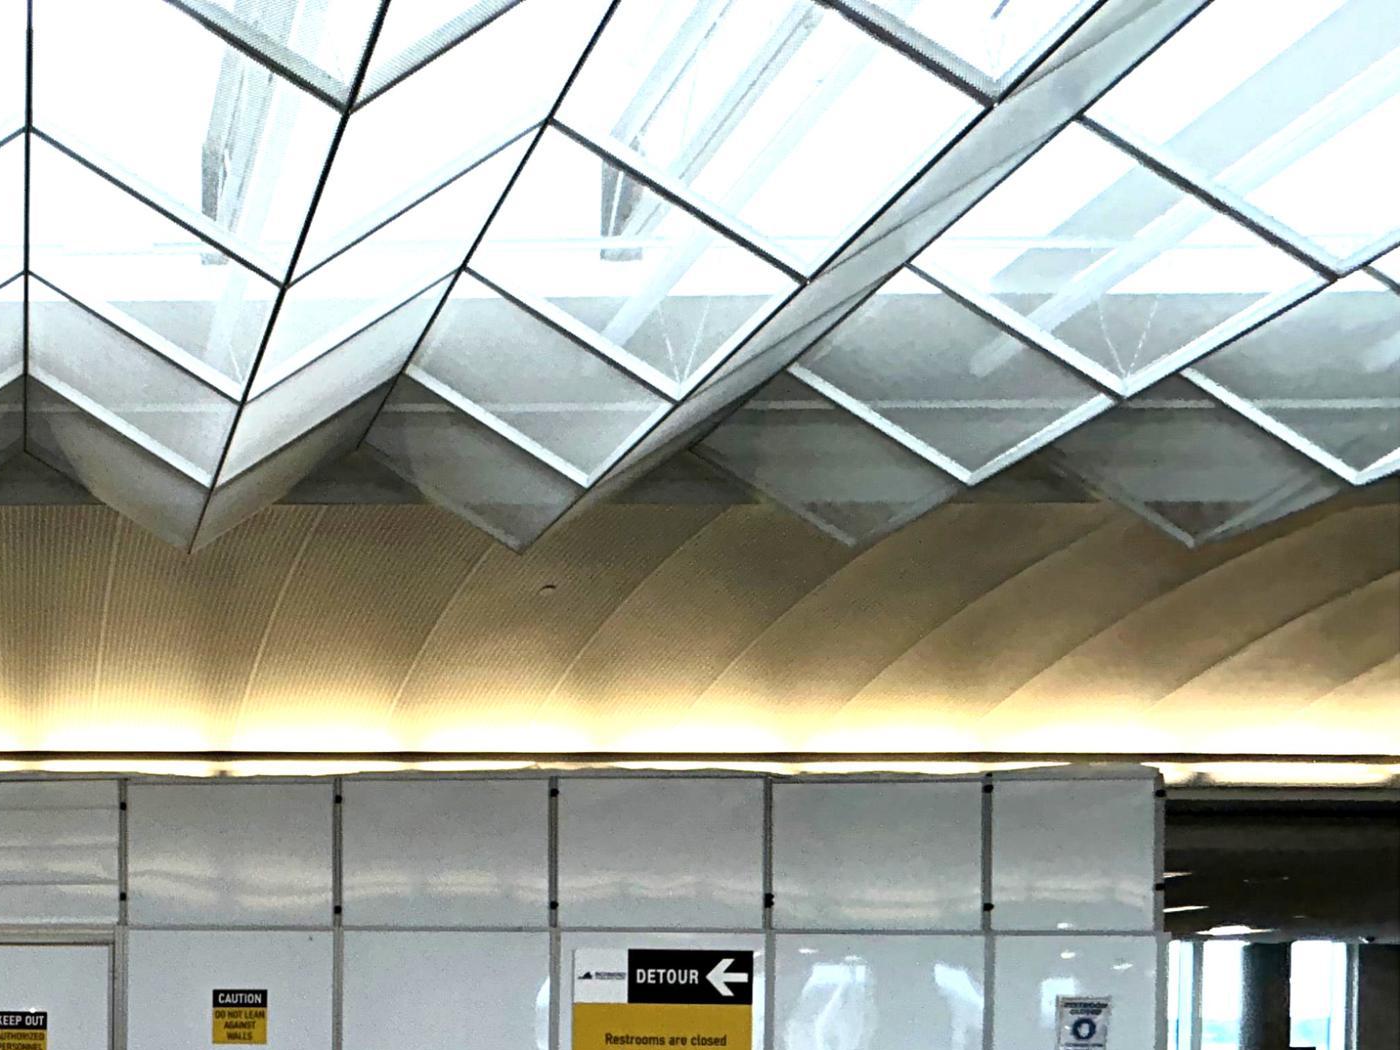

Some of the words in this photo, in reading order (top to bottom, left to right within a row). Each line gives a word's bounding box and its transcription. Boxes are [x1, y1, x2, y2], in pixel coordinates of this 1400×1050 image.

[636, 969, 699, 984] DETOUR
[218, 993, 262, 1004] CAUTION
[25, 1015, 44, 1026] OUT
[224, 1021, 256, 1029] AGAINST
[226, 1031, 252, 1040] WALLS
[605, 1032, 666, 1046] Restrooms
[668, 1036, 687, 1046] are
[690, 1034, 727, 1046] closed
